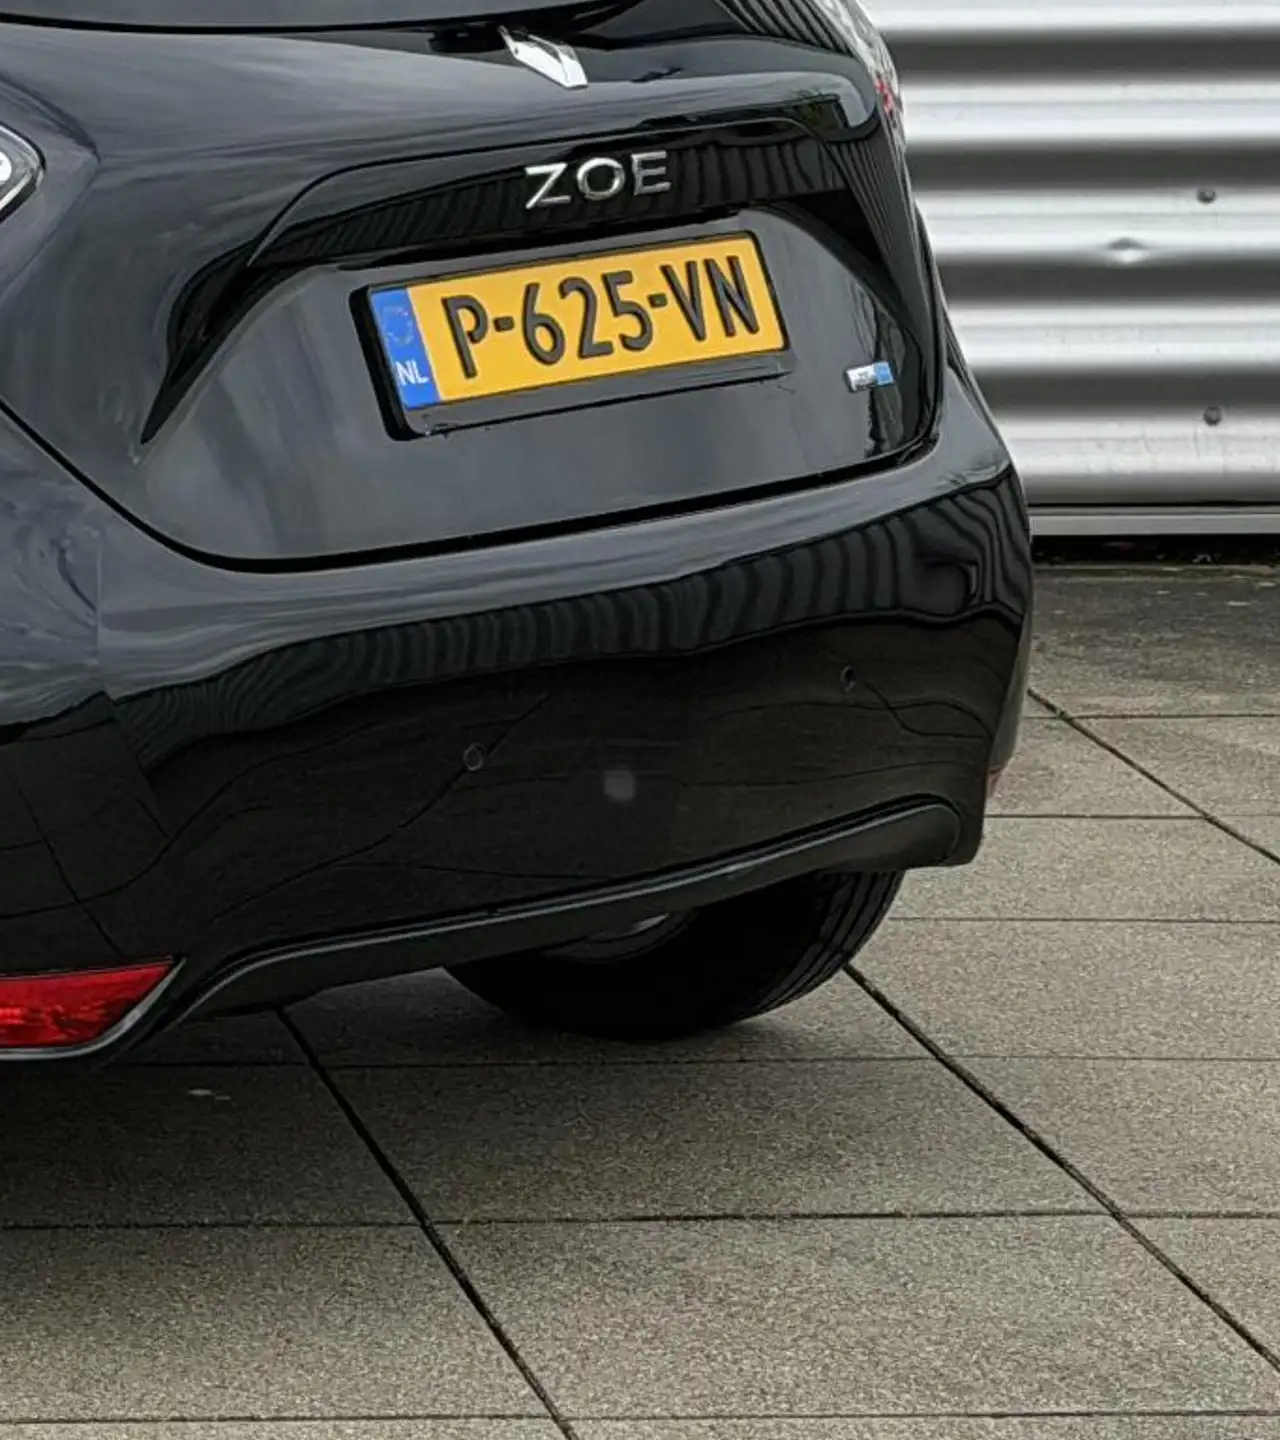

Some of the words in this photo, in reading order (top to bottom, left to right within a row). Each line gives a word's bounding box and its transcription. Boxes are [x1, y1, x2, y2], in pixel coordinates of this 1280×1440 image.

[524, 150, 673, 210] ZOE
[442, 256, 759, 378] P-625-VN
[395, 360, 429, 386] NL
